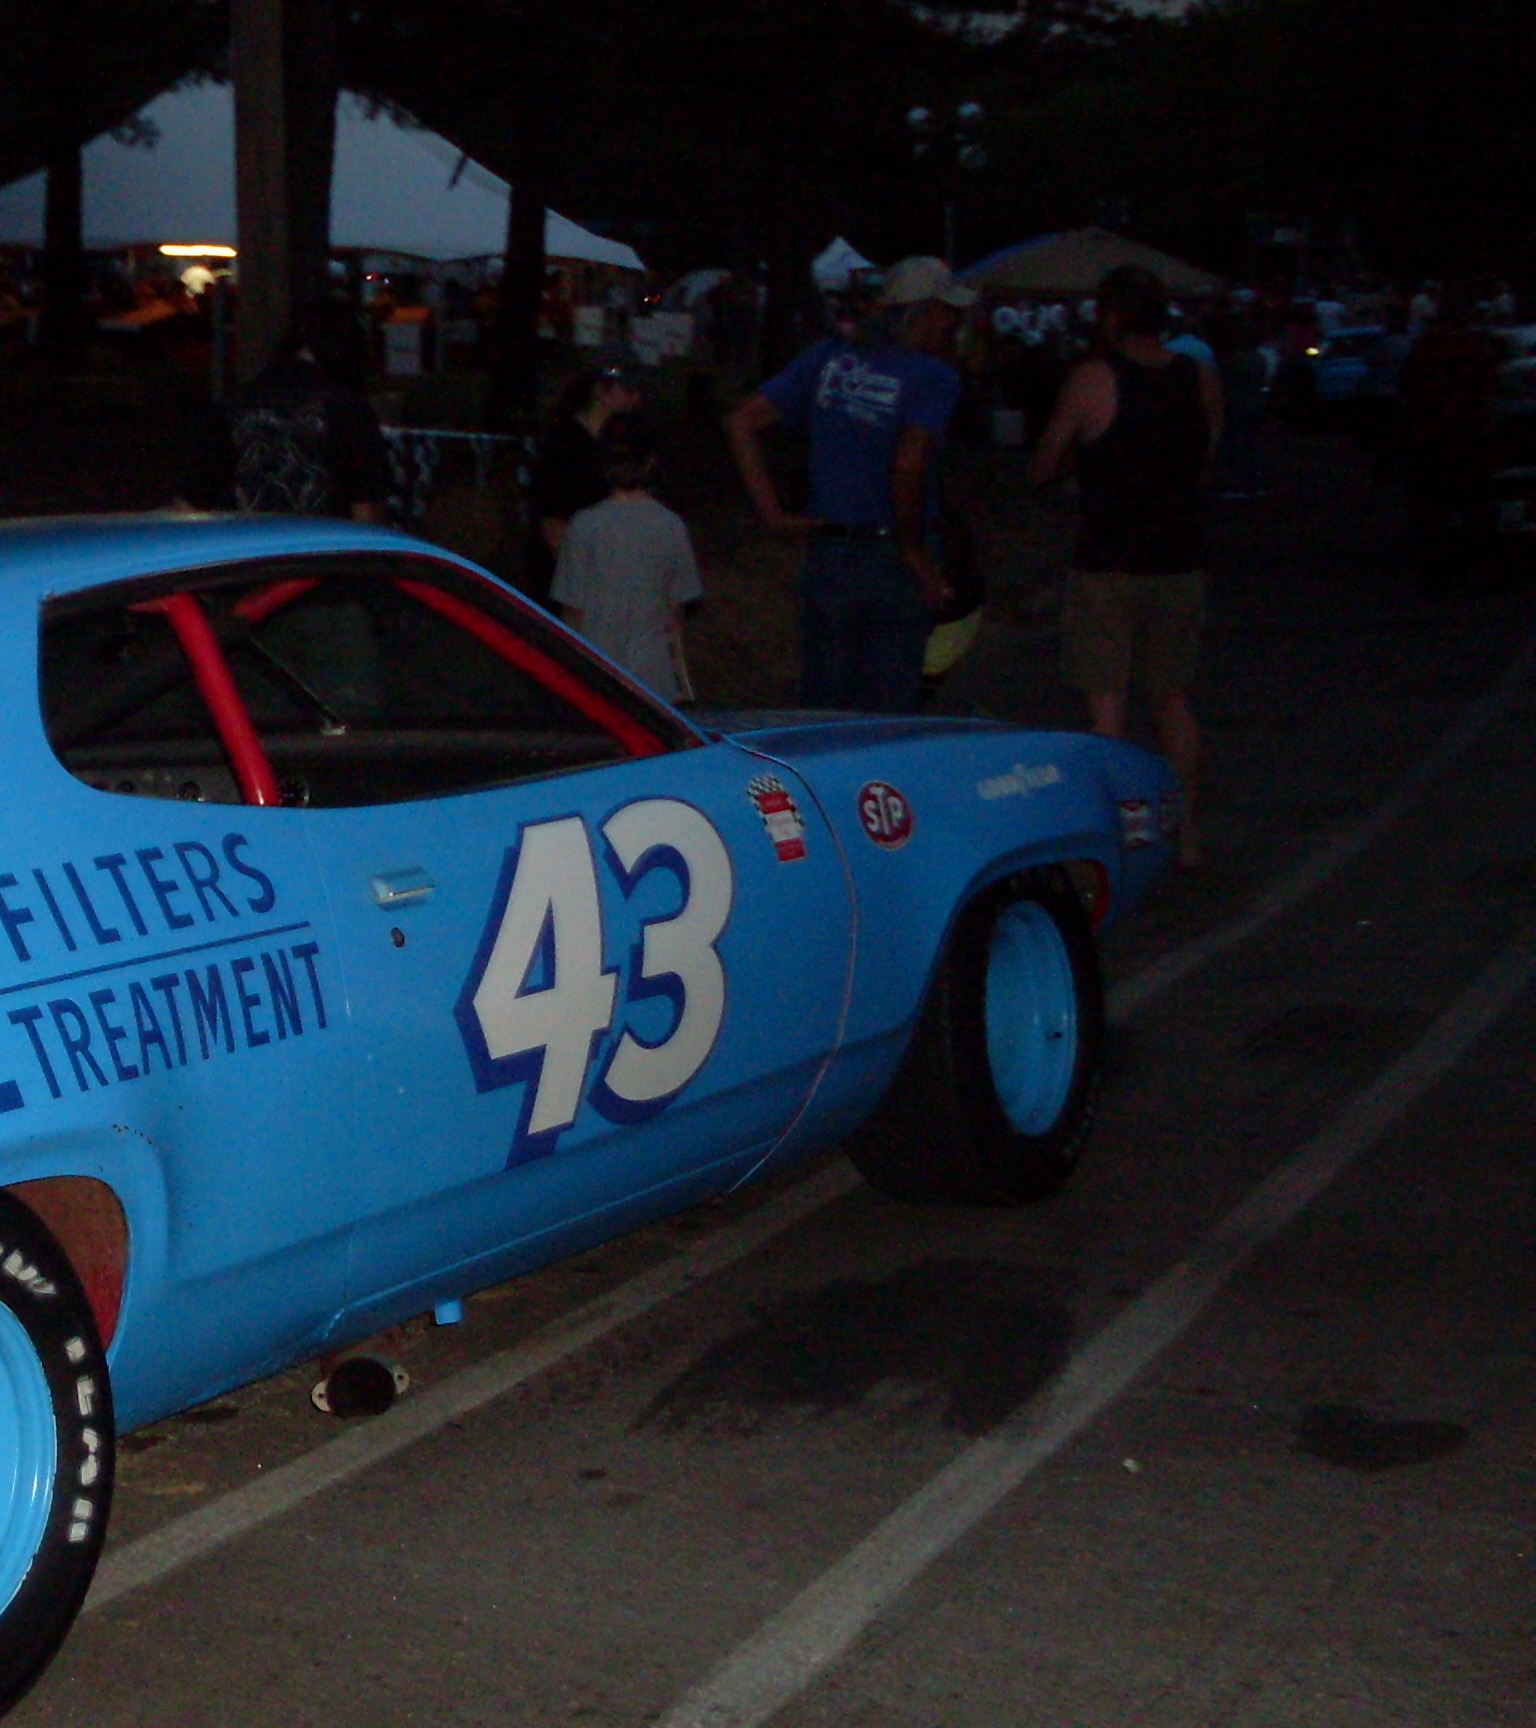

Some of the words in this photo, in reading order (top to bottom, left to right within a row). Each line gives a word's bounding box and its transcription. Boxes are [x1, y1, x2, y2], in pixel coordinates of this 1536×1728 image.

[863, 786, 904, 836] STP
[7, 941, 328, 1098] TREATMENT
[456, 797, 733, 1169] 43
